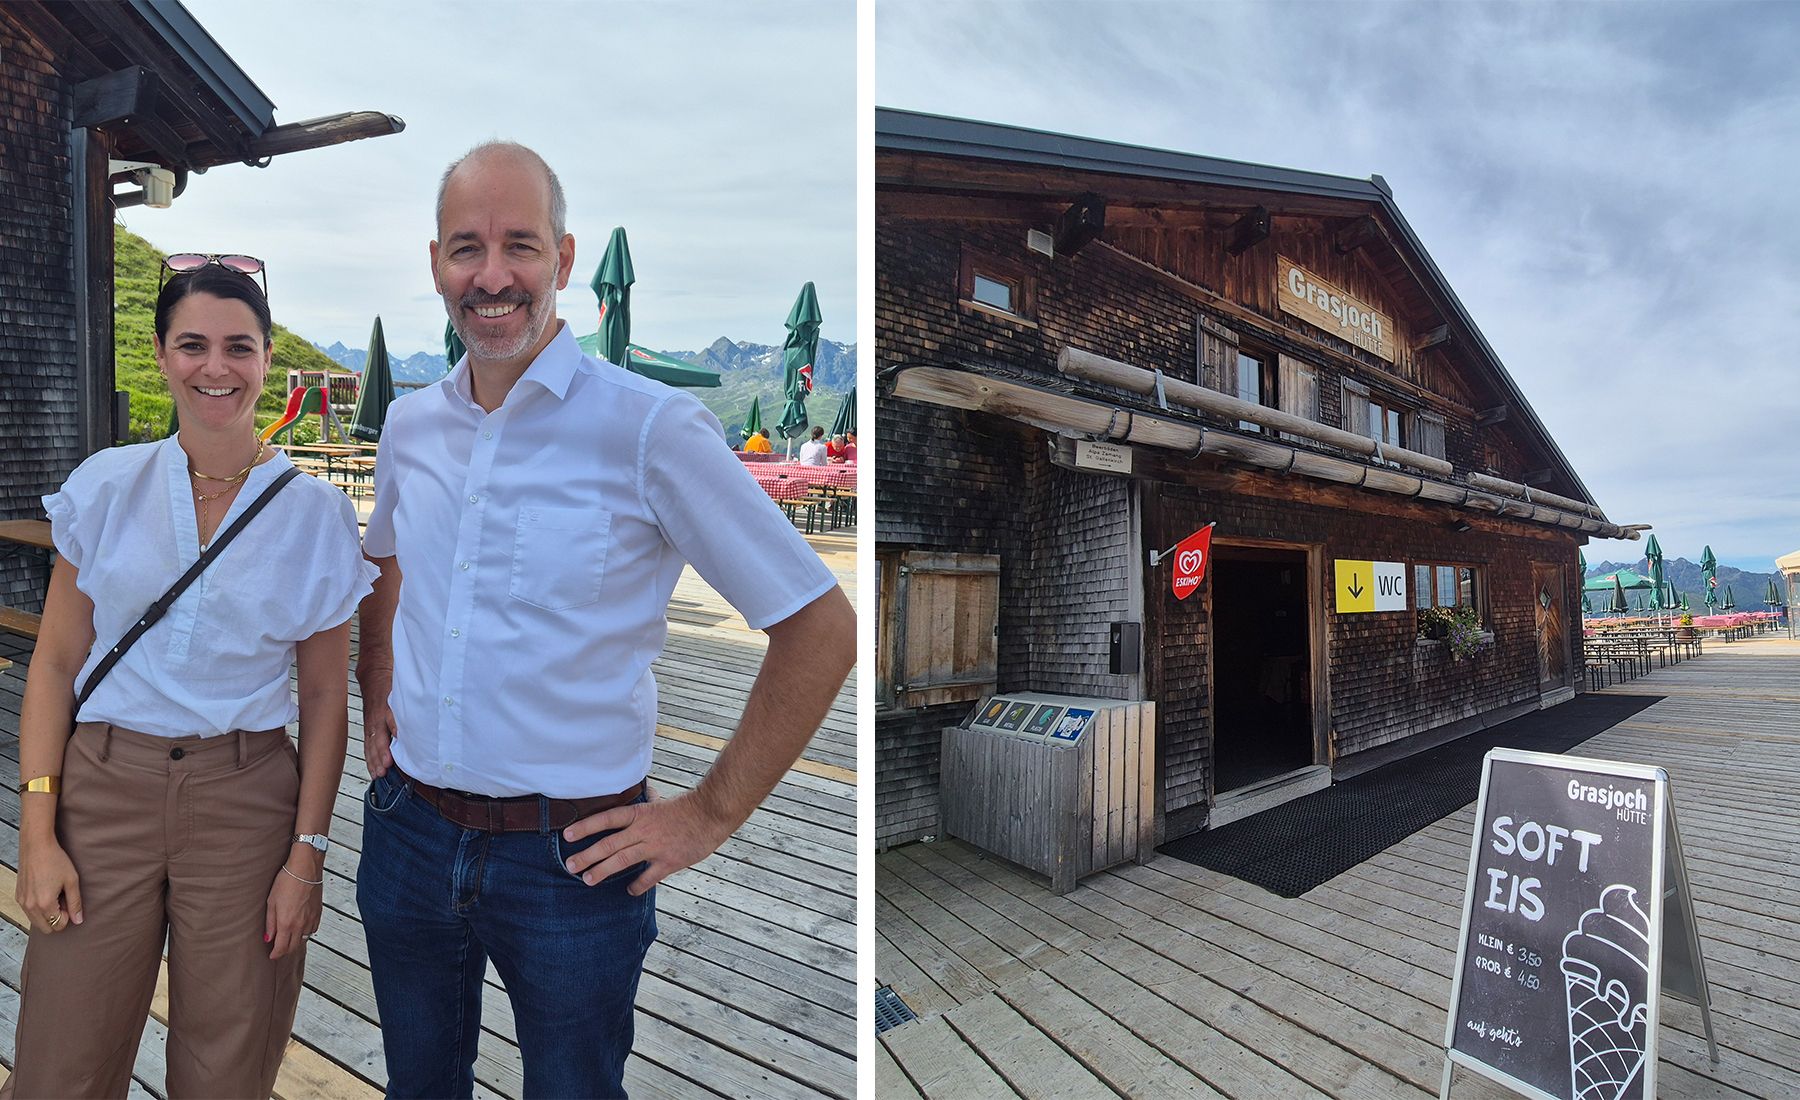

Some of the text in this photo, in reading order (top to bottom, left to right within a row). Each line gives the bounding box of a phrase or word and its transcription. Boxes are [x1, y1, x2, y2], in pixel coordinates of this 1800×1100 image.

[1288, 267, 1382, 340] Grasjoch
[1378, 575, 1402, 596] WC
[1567, 779, 1647, 810] Grasjoch
[1616, 808, 1647, 825] HÜTTE
[1492, 816, 1603, 873] SOFT
[1484, 867, 1546, 922] EIS
[1478, 933, 1543, 967] KLEIN € 3,50
[1503, 967, 1512, 979] €
[1517, 969, 1540, 990] 4,50
[1467, 1020, 1487, 1038] auf
